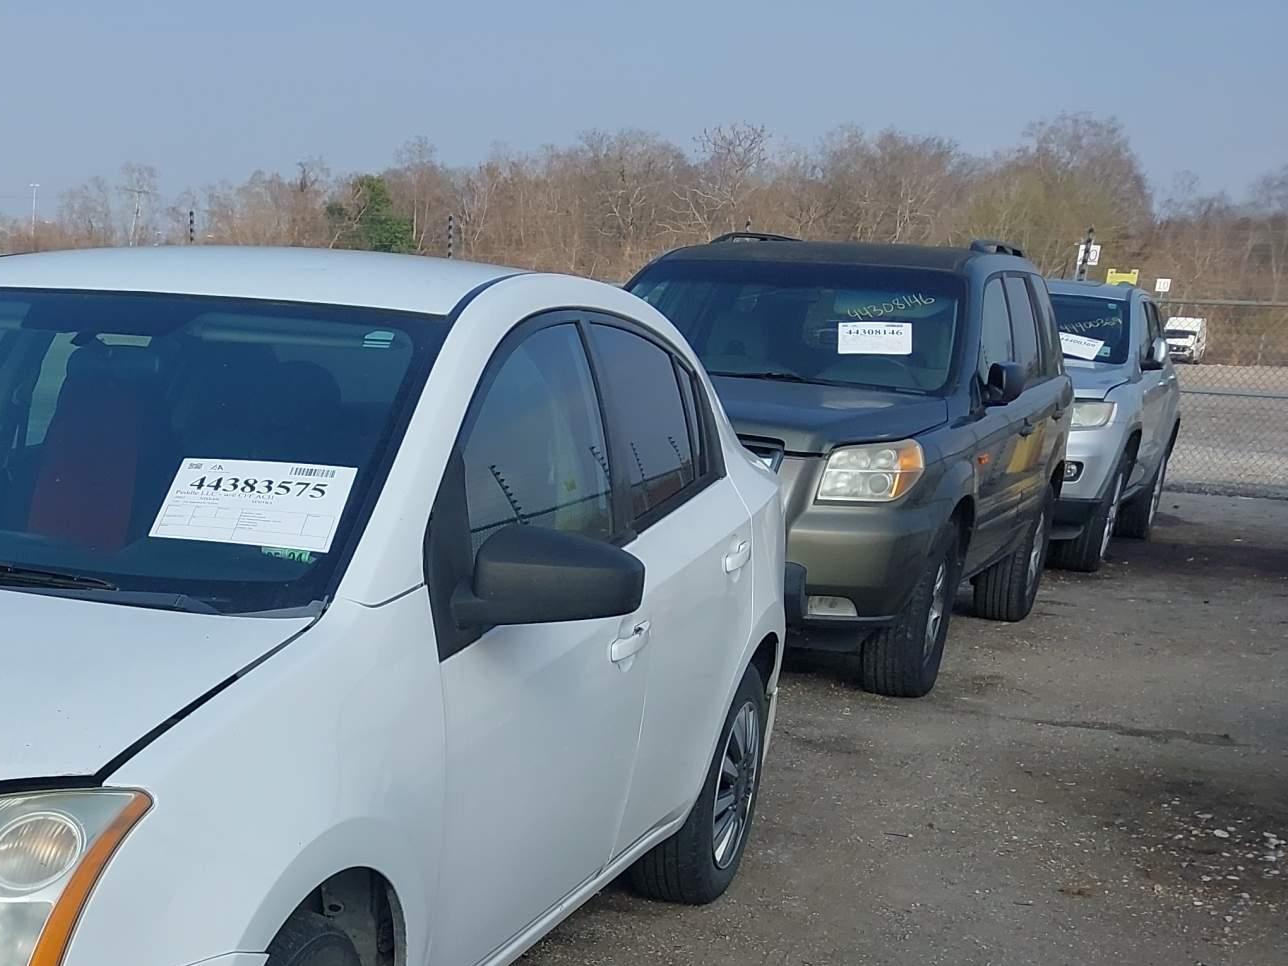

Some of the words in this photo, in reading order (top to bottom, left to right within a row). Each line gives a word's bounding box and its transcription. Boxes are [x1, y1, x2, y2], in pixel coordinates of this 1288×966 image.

[847, 292, 936, 320] 44308146
[845, 328, 903, 336] 44308146
[189, 475, 328, 499] 44383575
